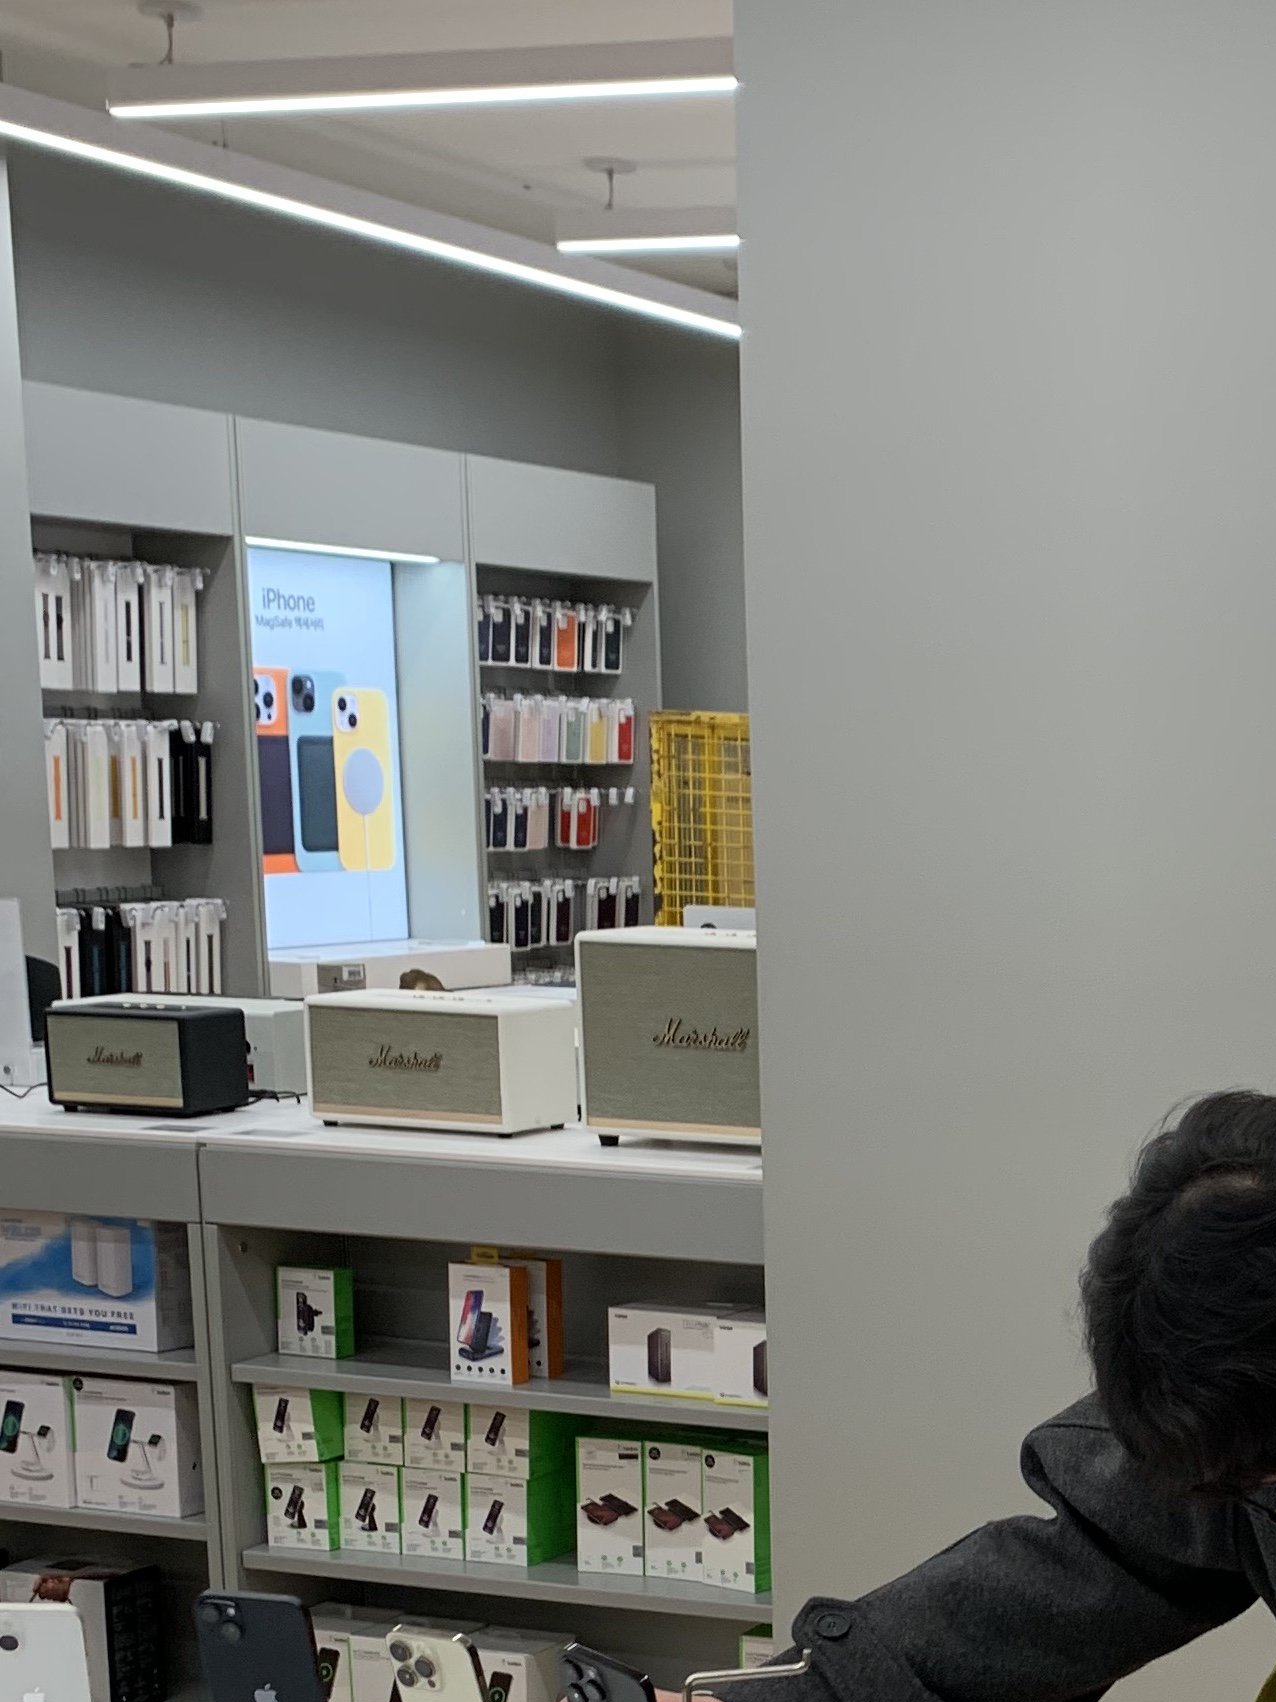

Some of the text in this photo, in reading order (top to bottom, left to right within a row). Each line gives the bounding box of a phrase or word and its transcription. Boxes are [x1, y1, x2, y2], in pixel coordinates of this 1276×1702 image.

[262, 587, 316, 613] iPhone
[652, 1017, 750, 1053] Marshall
[86, 1046, 143, 1069] Marshall
[368, 1045, 443, 1072] Marshall
[88, 1308, 108, 1318] YOU
